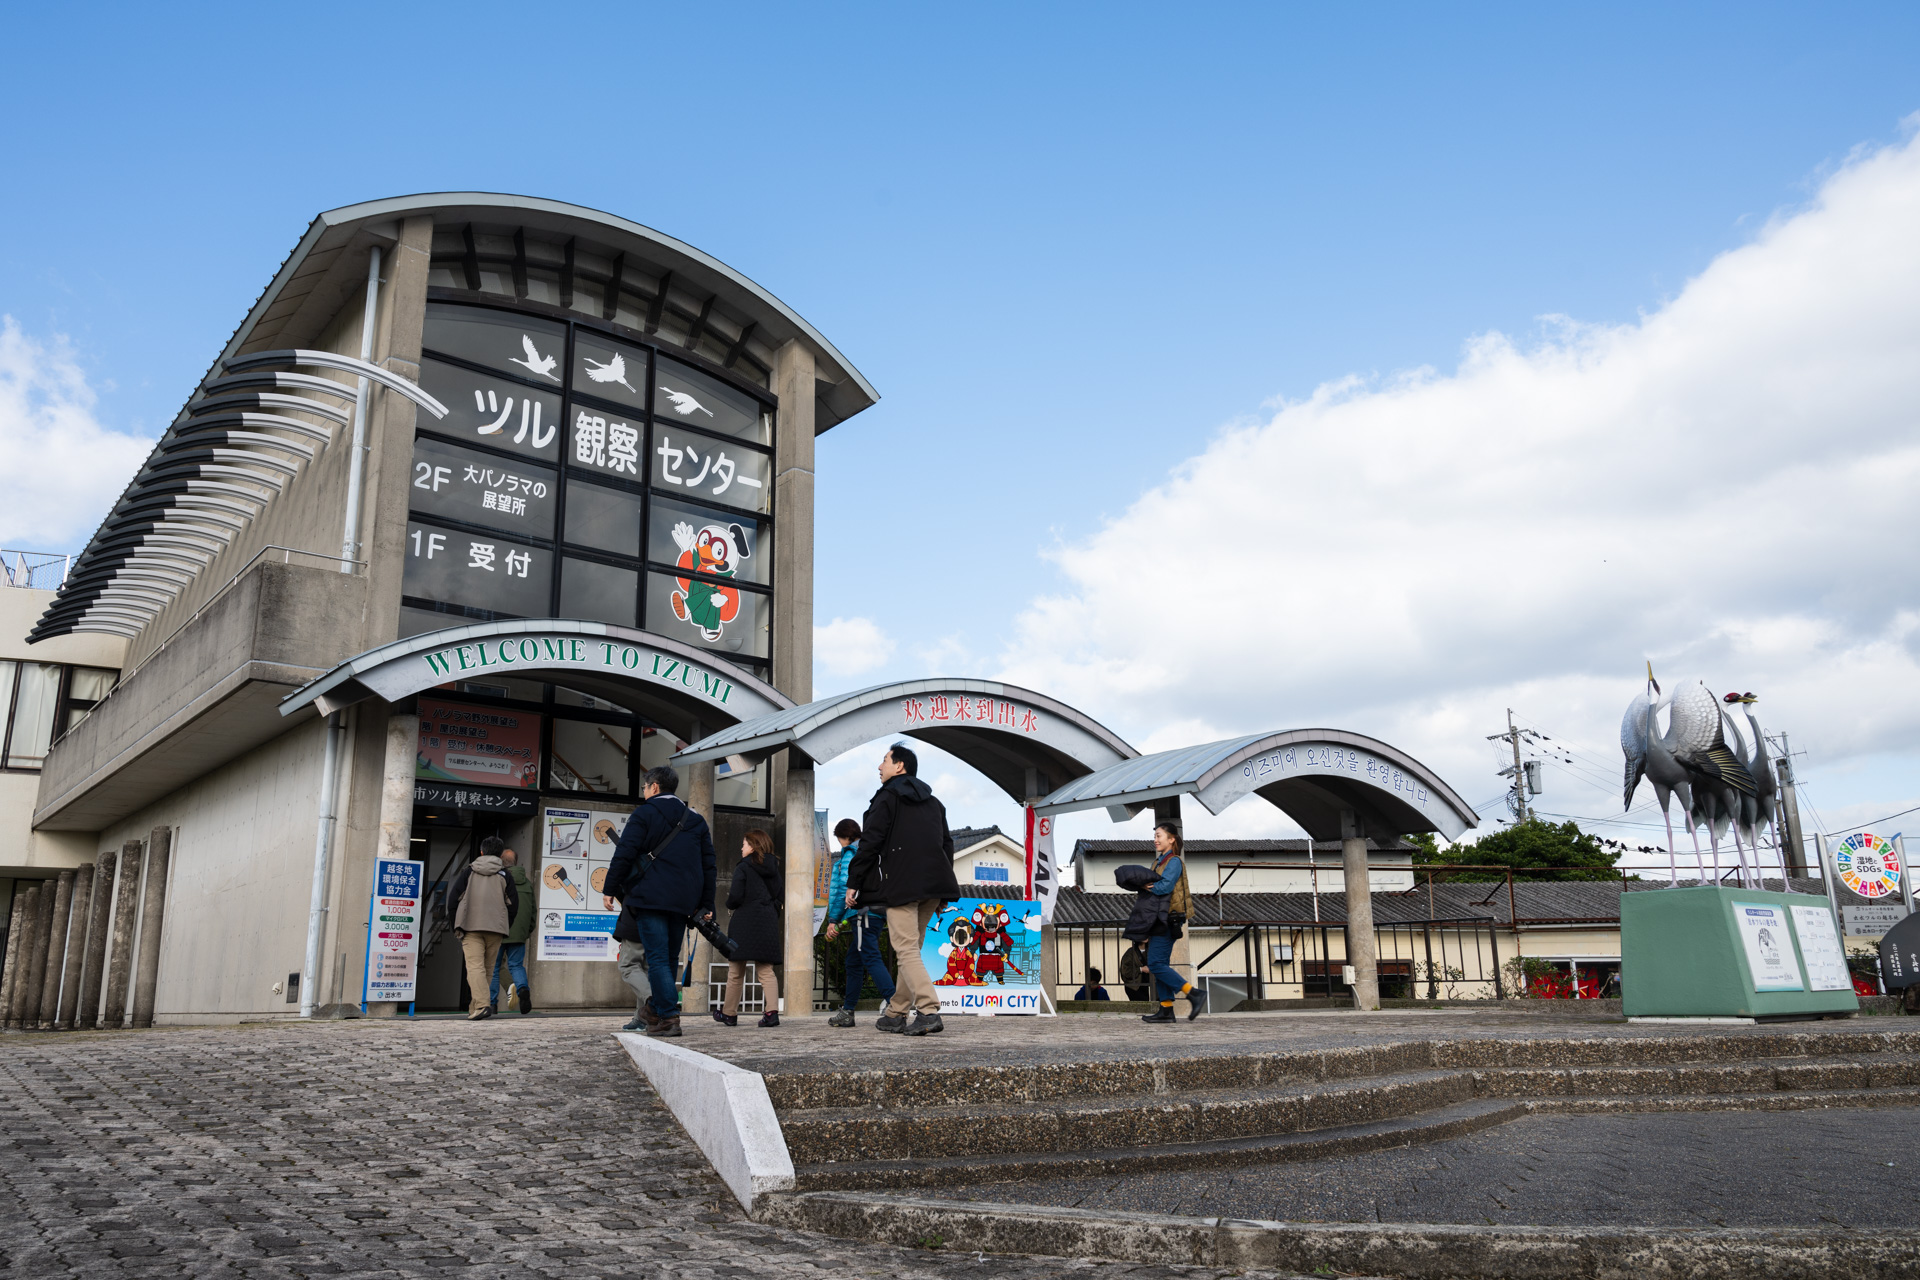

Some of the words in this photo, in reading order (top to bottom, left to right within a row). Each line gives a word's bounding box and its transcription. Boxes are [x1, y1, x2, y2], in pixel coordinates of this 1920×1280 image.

[474, 390, 556, 449] ツル
[575, 411, 639, 474] 観察
[657, 437, 762, 495] センター
[414, 462, 452, 492] 2F
[463, 465, 547, 498] 大パノラマの
[482, 492, 526, 516] 展望所
[411, 530, 447, 559] 1F
[424, 638, 587, 677] WELCOME
[599, 641, 639, 670] TO
[650, 652, 734, 705] IZUMI
[433, 708, 518, 728] パノラマ野外展望台
[901, 694, 1038, 732] 欢迎来到出水
[1243, 748, 1298, 781] 이즈미에
[1306, 747, 1359, 772] 오신것을
[1366, 758, 1428, 808] 환영합니다
[382, 874, 416, 886] 環境保全
[387, 864, 413, 875] 越冬地
[1857, 865, 1882, 873] SDGs
[386, 885, 411, 896] 協力金
[388, 906, 410, 914] 1,000円
[951, 999, 959, 1007] to
[961, 995, 1003, 1008] IZUMI
[1007, 995, 1038, 1008] CITY
